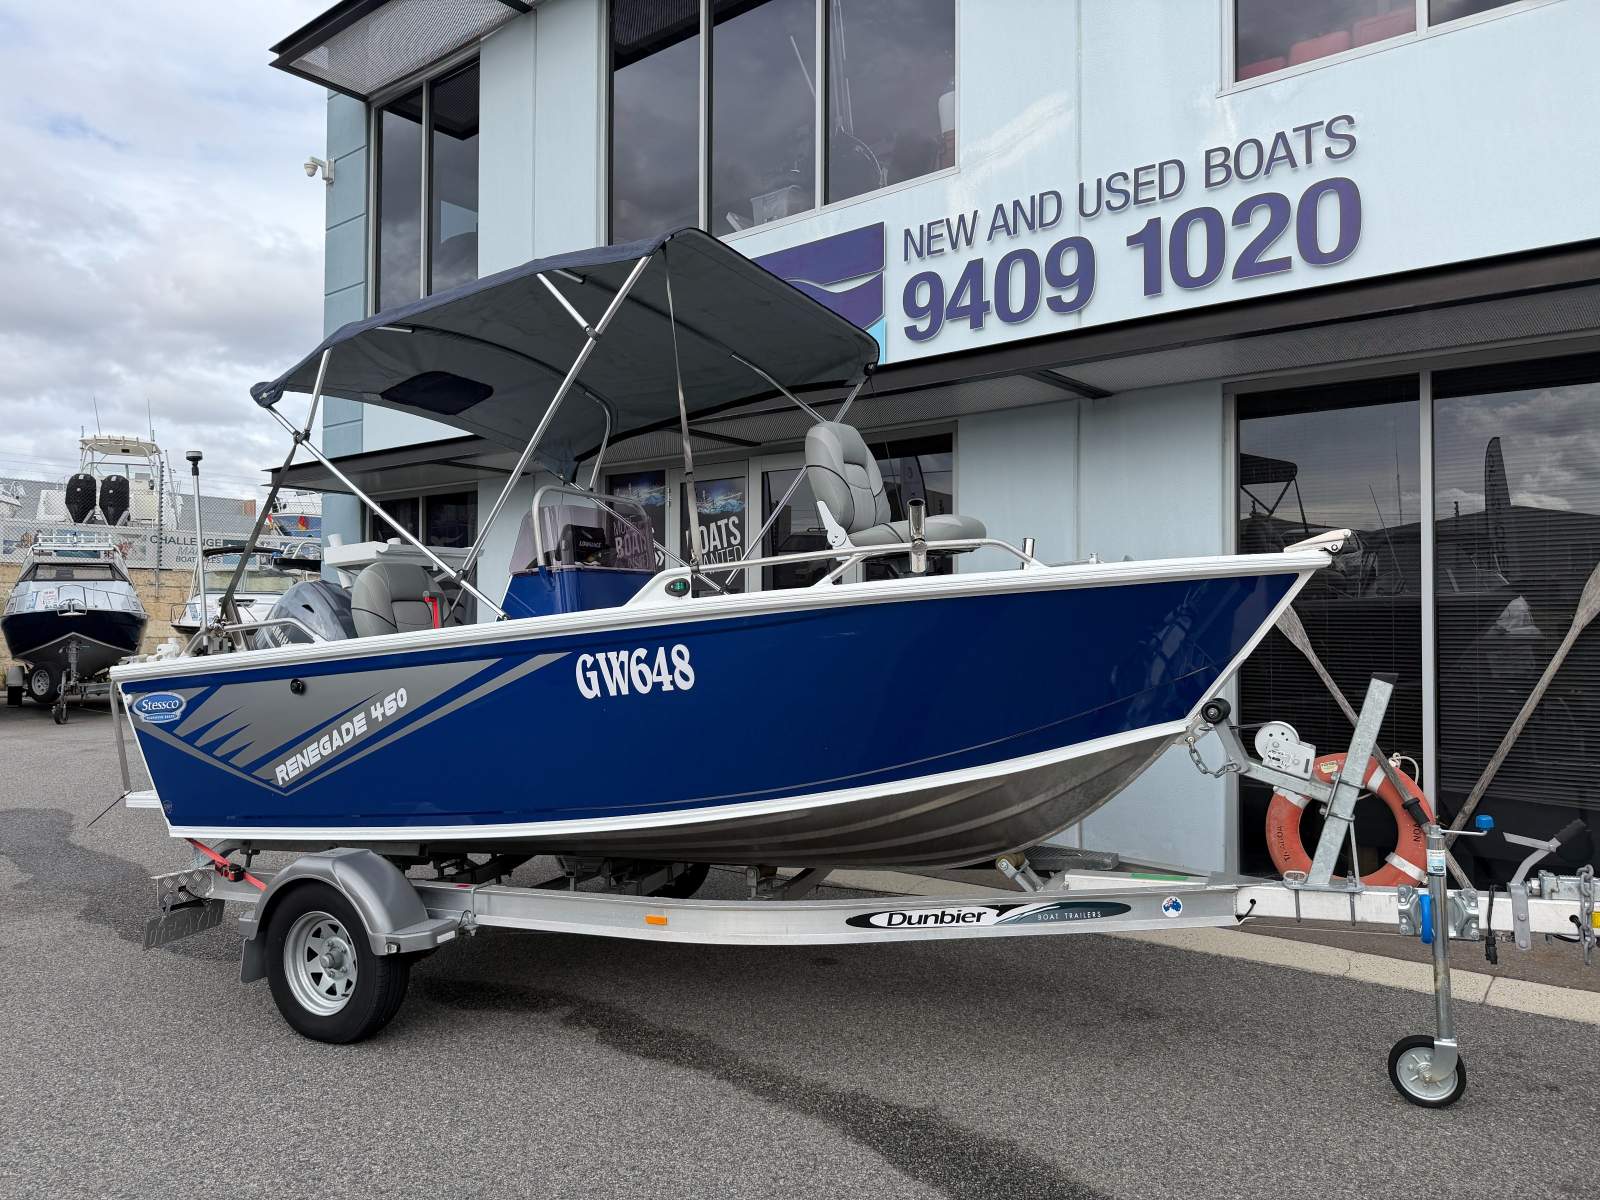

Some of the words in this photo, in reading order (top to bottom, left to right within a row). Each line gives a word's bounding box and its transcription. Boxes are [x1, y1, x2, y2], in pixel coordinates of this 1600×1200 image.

[903, 210, 979, 262] NEW
[987, 190, 1063, 242] AND
[1078, 158, 1186, 218] USED
[1204, 114, 1357, 189] BOATS
[902, 235, 1096, 342] 9409
[1126, 176, 1362, 297] 1020
[150, 535, 222, 547] CHALLENGE
[614, 527, 655, 558] BOAT
[686, 516, 741, 554] OATS
[575, 643, 695, 700] GW648
[142, 699, 179, 711] Stessco
[274, 711, 368, 786] RENEGADE
[370, 687, 408, 722] 460
[886, 909, 987, 927] Dunbier
[1037, 913, 1059, 921] BOAT
[1064, 911, 1102, 920] TRAILERS
